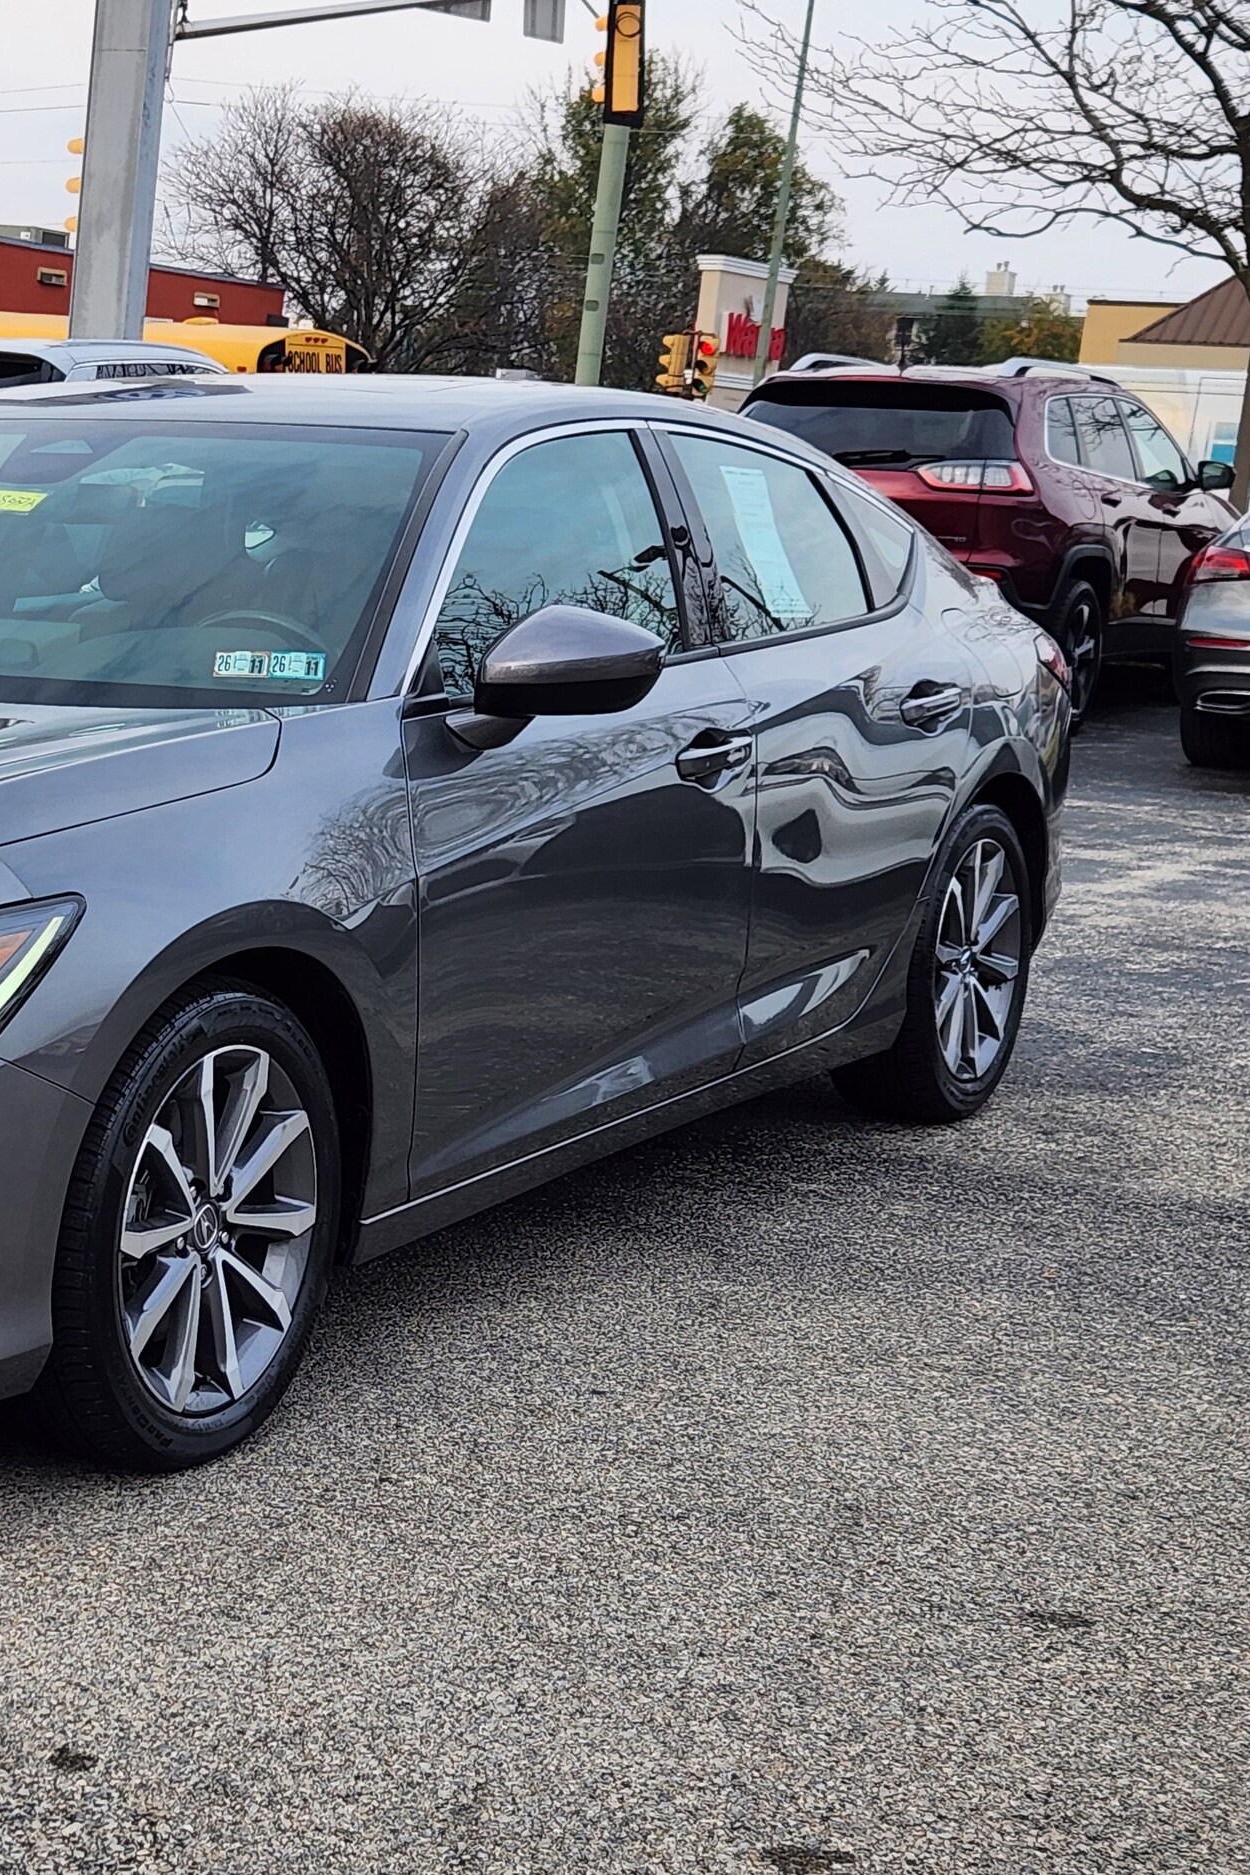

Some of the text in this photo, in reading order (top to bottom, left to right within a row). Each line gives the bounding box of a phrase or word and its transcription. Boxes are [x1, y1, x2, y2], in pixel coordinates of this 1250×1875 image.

[725, 312, 786, 361] Waa
[287, 350, 342, 373] SCHOOL BUS
[217, 654, 319, 676] 26 11 26 11
